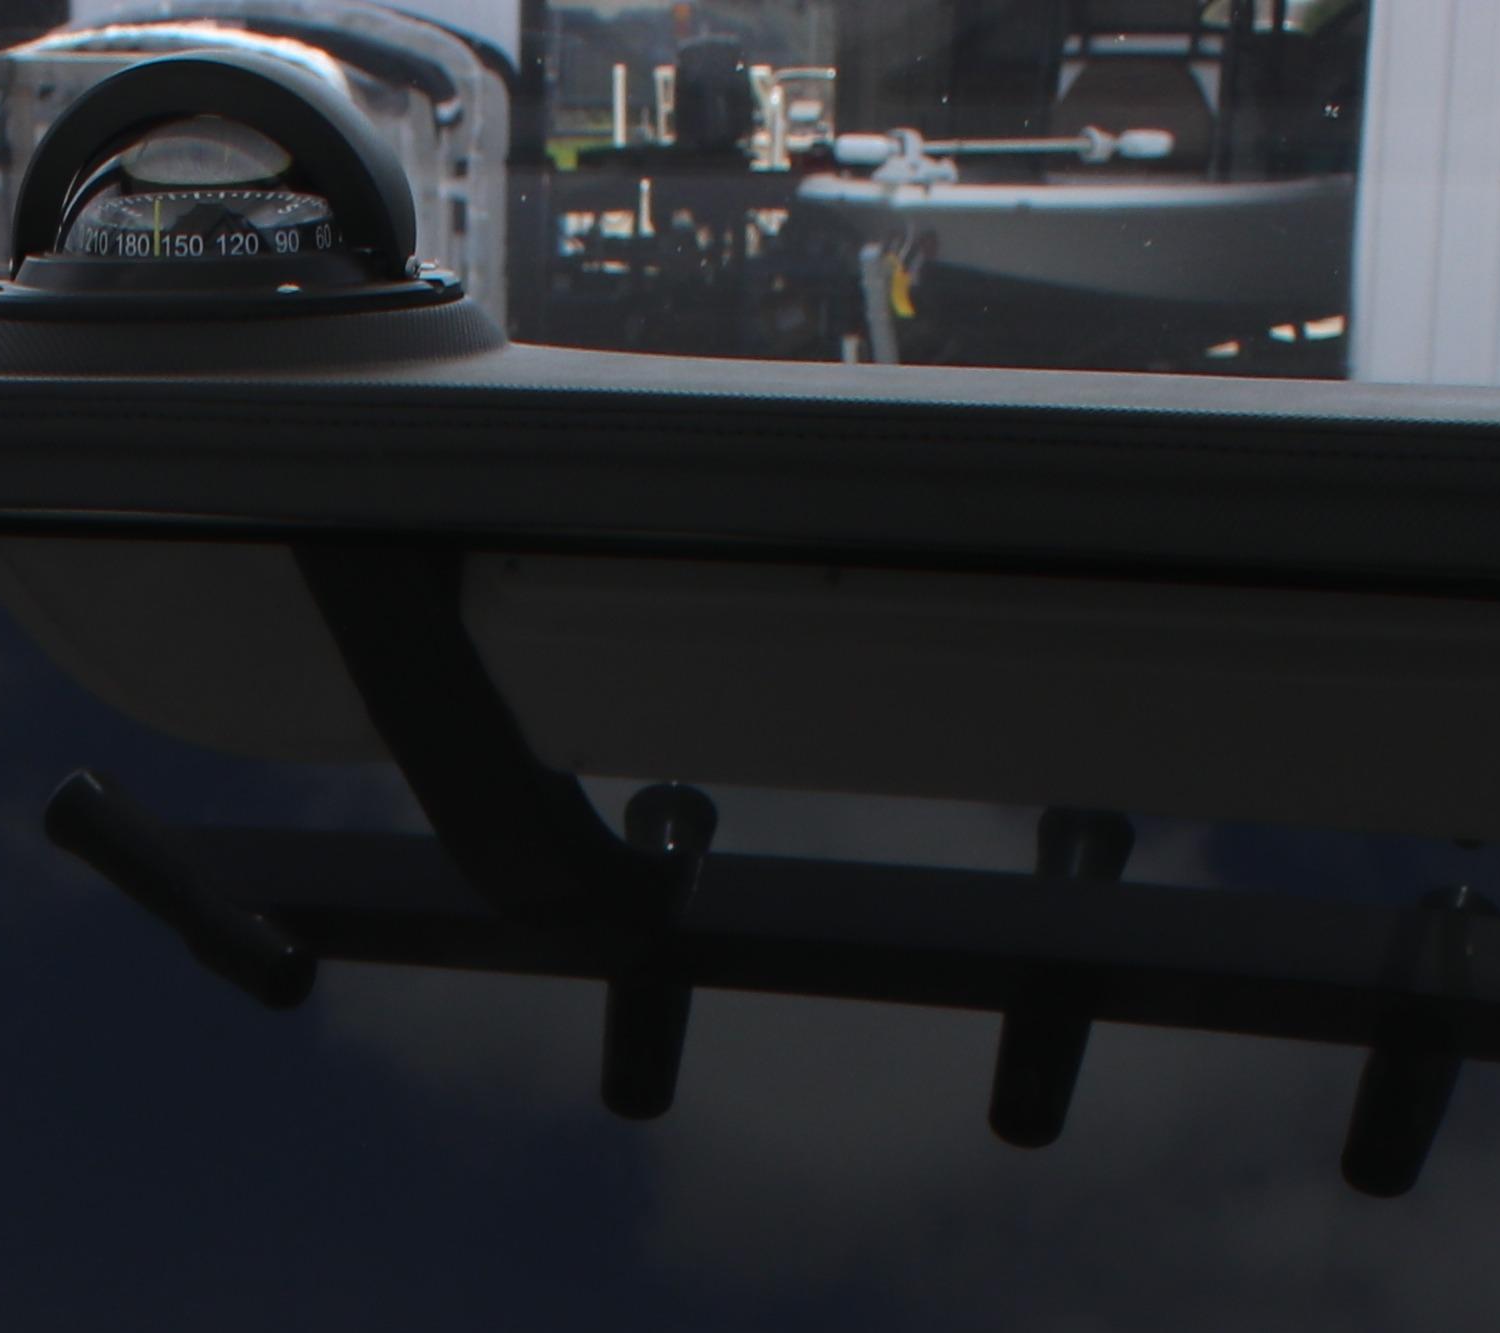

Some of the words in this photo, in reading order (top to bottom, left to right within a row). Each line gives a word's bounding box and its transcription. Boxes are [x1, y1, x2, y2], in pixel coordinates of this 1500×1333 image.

[83, 227, 108, 255] 210
[116, 233, 150, 257] 180
[162, 234, 204, 257] 150
[216, 232, 259, 256] 120
[274, 229, 300, 253] 90
[315, 223, 332, 250] 60
